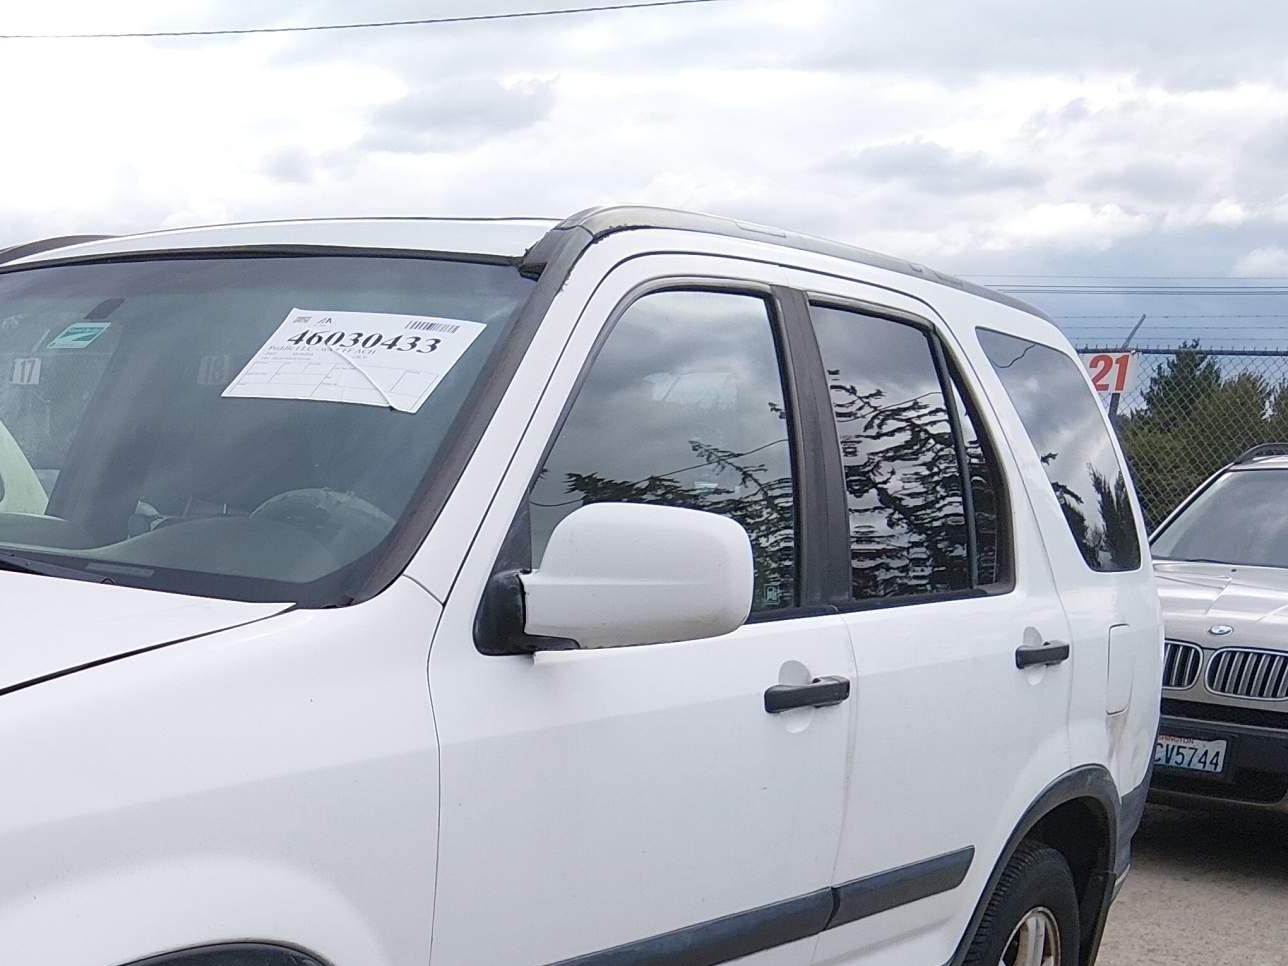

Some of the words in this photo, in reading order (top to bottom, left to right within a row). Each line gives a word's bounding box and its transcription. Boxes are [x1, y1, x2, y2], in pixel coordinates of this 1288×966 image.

[287, 328, 442, 354] 46030433
[20, 359, 36, 384] 17
[1089, 354, 1130, 392] 21
[1154, 742, 1222, 771] CV5744
